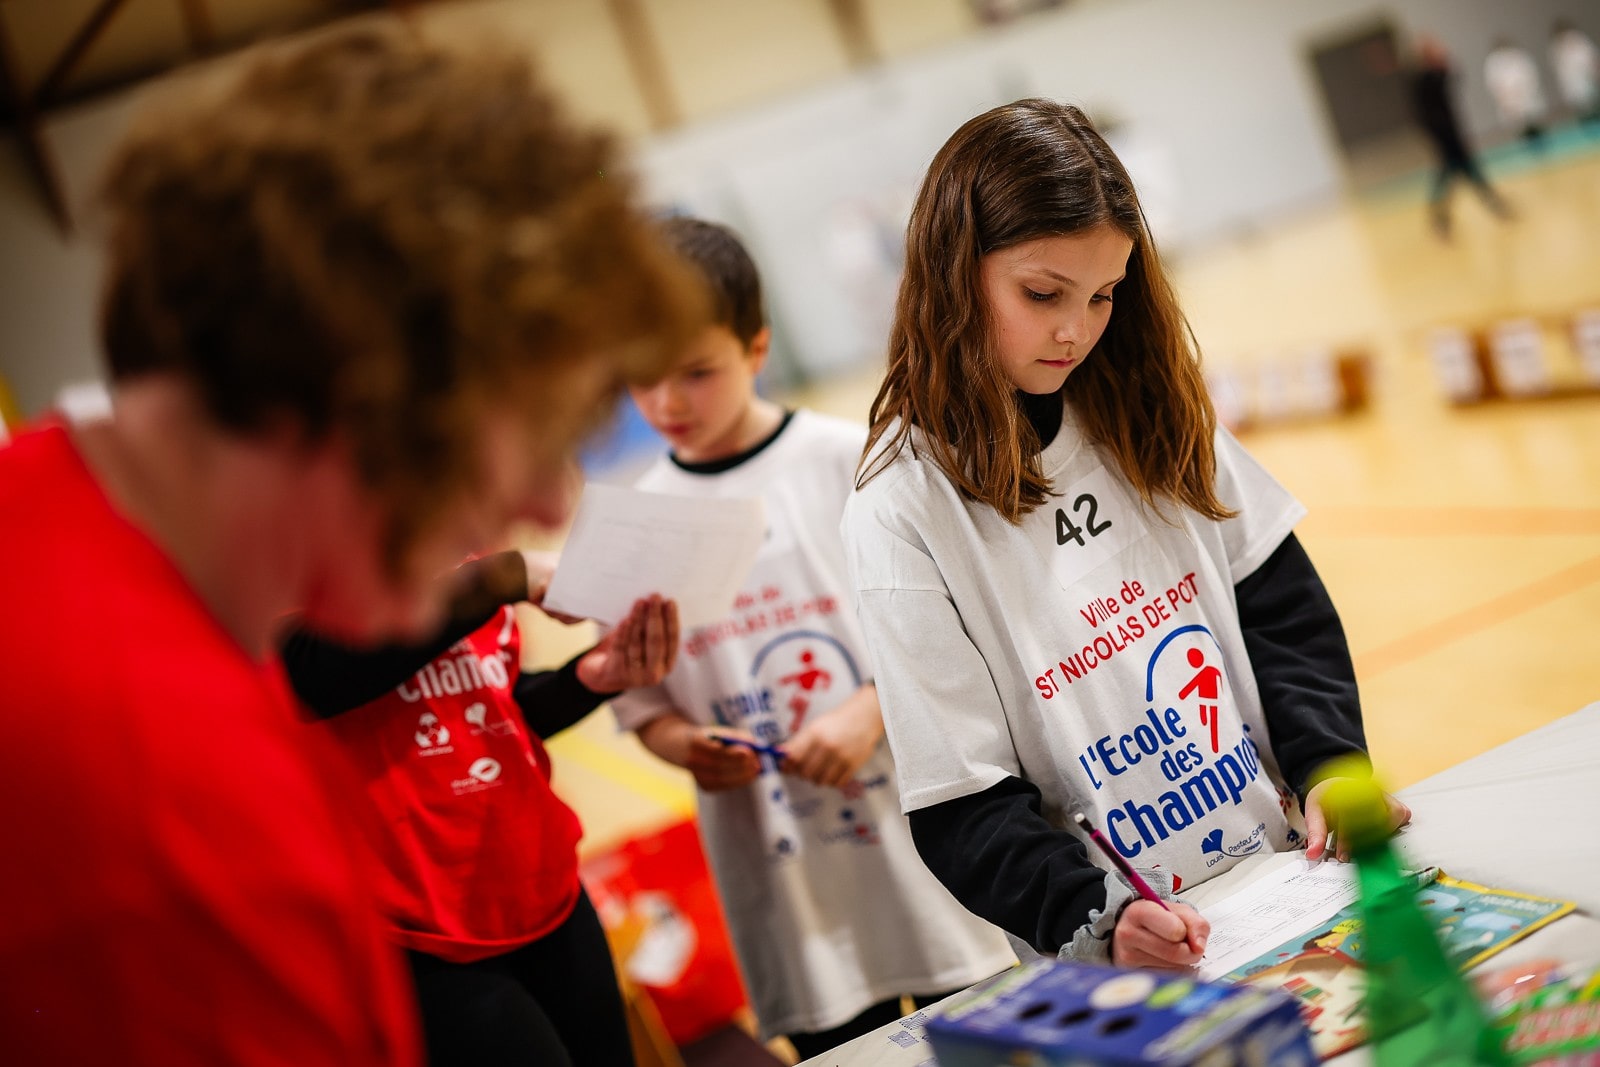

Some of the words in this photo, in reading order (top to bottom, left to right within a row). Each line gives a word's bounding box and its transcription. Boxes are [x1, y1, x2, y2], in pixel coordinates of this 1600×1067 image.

[1055, 493, 1112, 546] 42
[1079, 597, 1120, 628] Ville
[1120, 579, 1145, 605] de
[1035, 668, 1060, 699] ST
[1058, 615, 1145, 684] NICOLAS
[1142, 597, 1171, 628] DE
[1160, 742, 1204, 781] des
[1206, 853, 1225, 868] Louis
[1228, 836, 1253, 854] Pasteur
